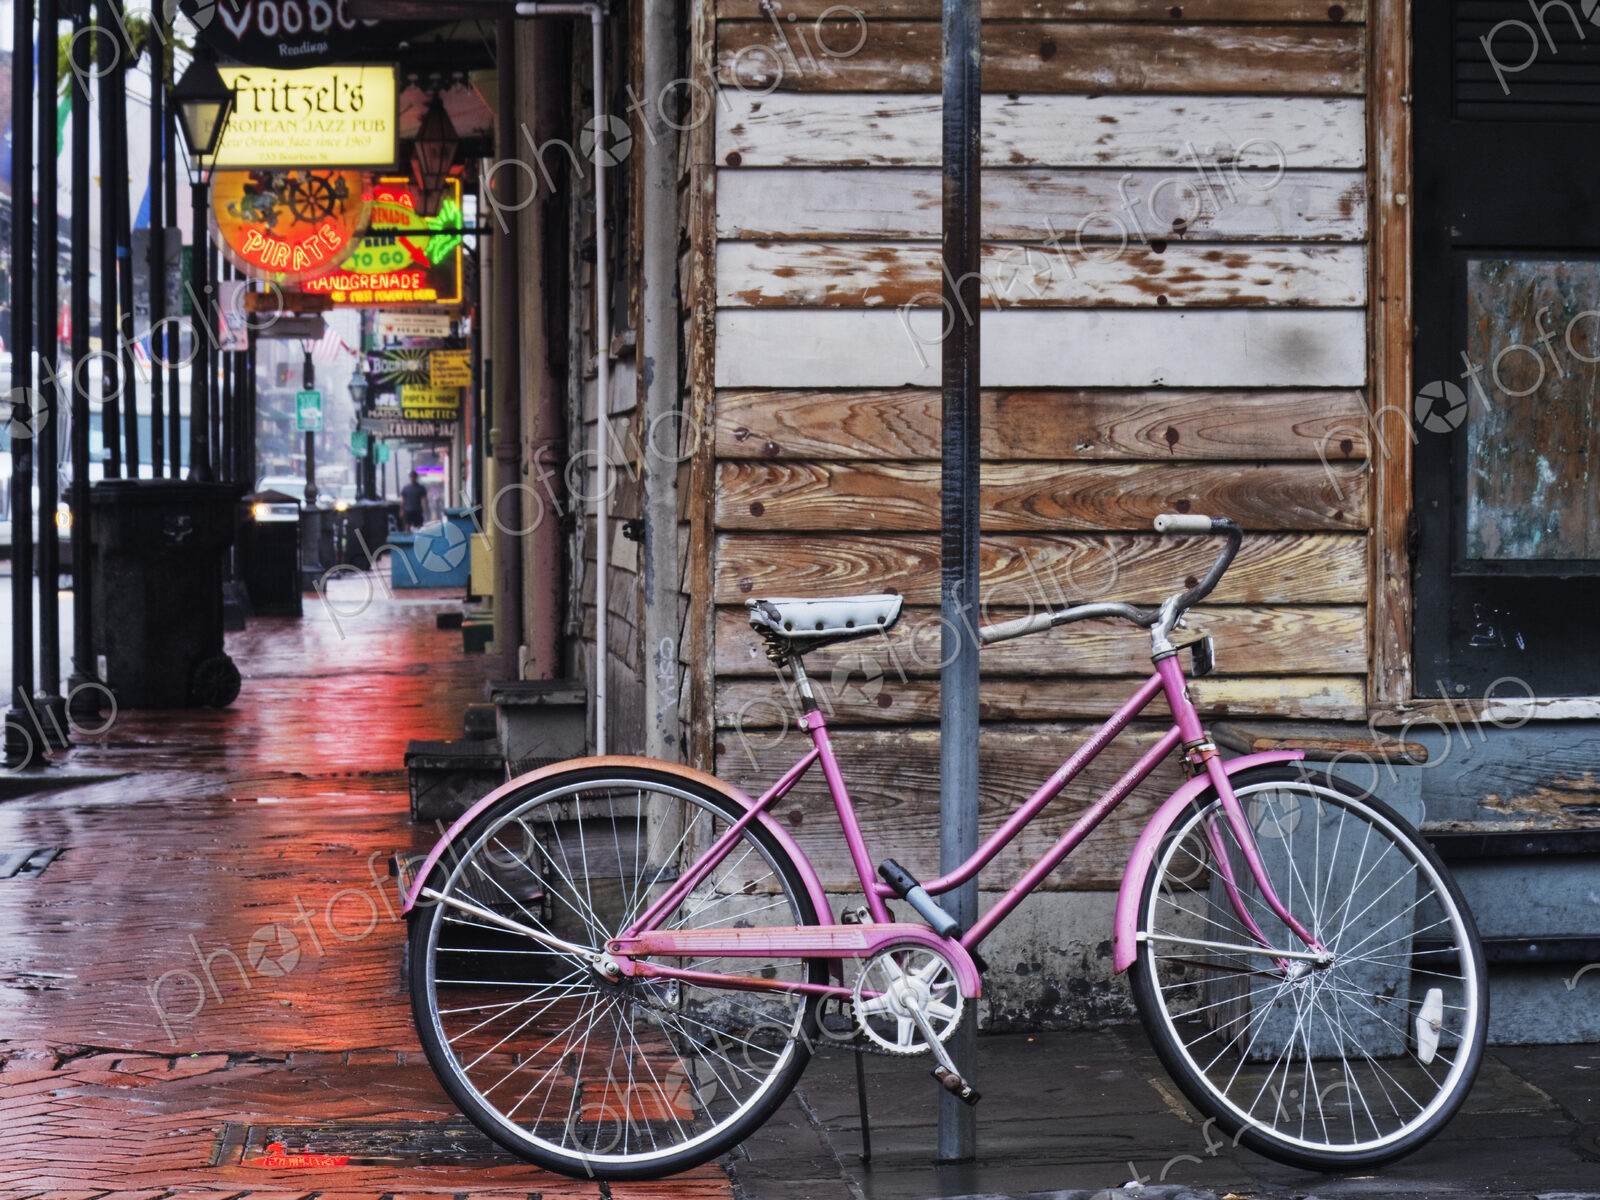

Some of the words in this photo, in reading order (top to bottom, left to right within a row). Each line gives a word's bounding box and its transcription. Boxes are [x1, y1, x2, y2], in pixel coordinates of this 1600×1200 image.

[217, 0, 380, 41] VOODO
[303, 119, 345, 133] JAZZ
[352, 119, 386, 133] PUB
[289, 135, 313, 148] Jazz
[242, 224, 341, 271] PIRATE
[352, 253, 373, 267] TO
[380, 251, 404, 264] GO
[404, 409, 457, 419] CIGARETTES
